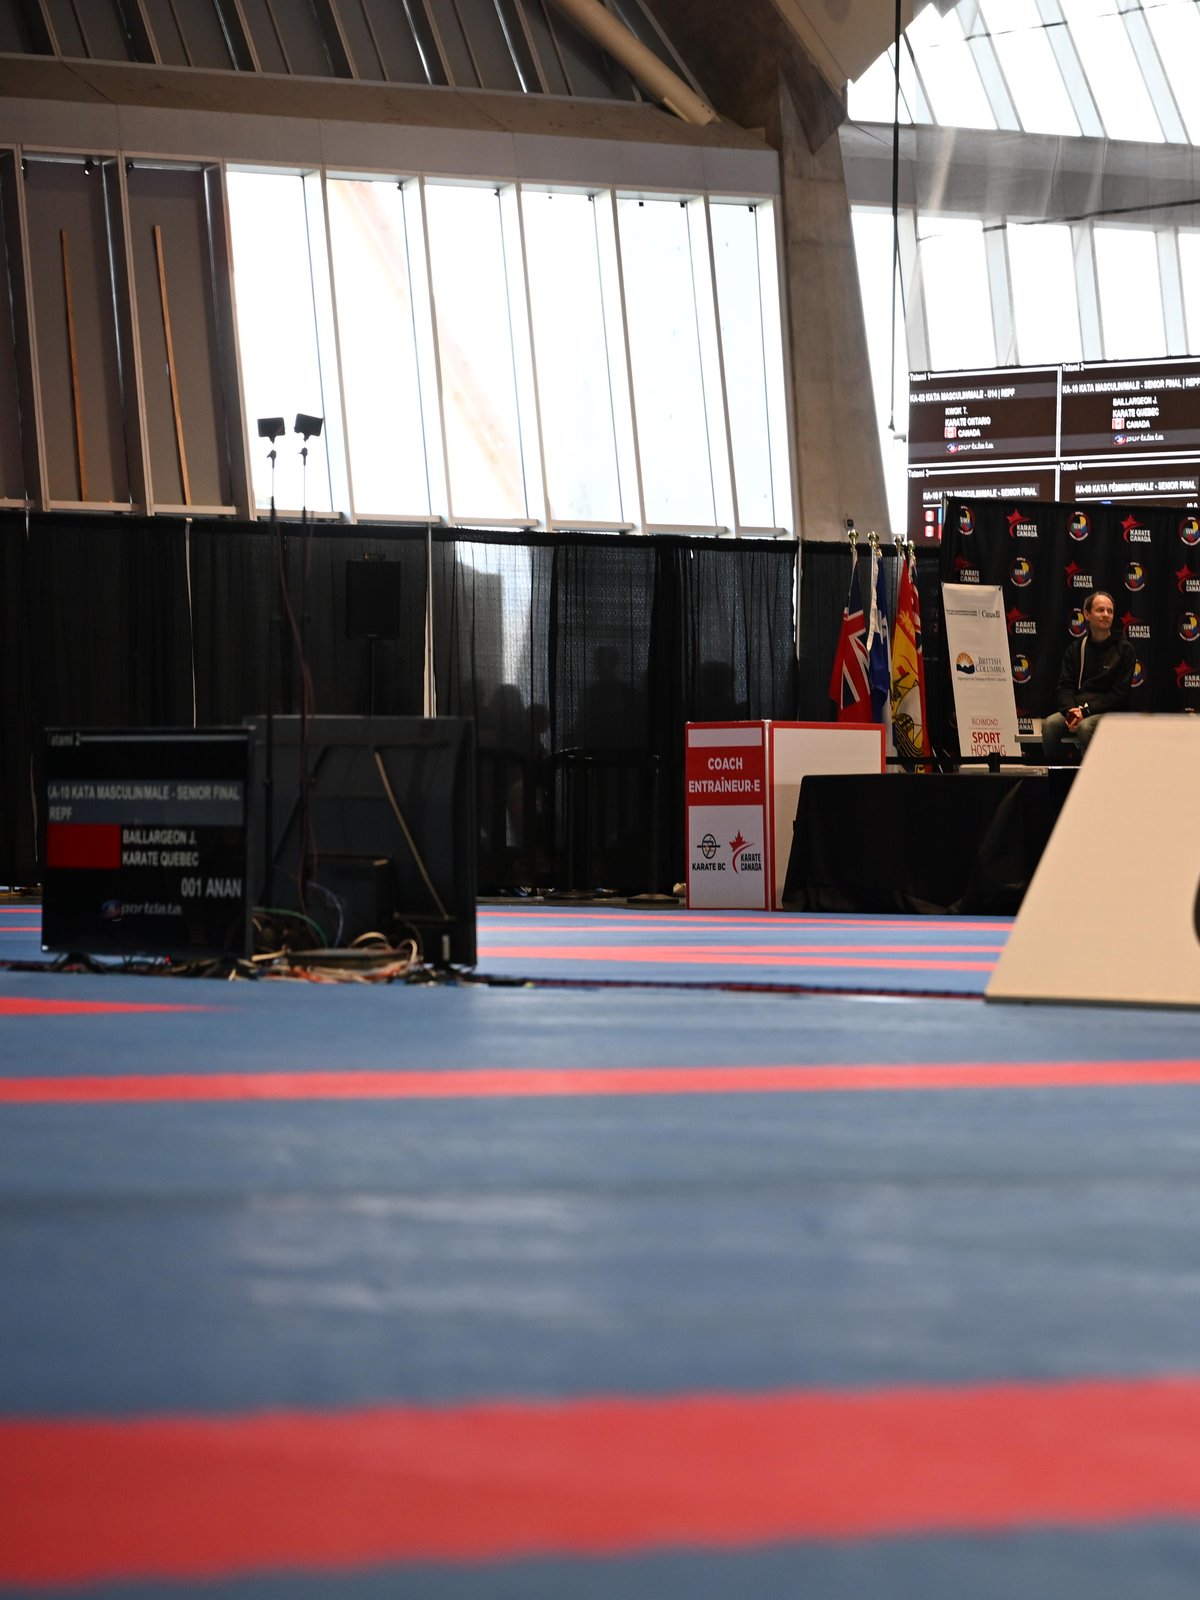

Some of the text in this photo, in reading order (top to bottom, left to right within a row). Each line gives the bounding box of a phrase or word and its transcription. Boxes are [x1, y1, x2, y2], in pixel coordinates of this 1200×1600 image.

[1079, 383, 1095, 392] KATA
[1144, 379, 1165, 389] SENIOR
[1165, 378, 1182, 388] FINAL
[926, 392, 940, 402] KATA
[1112, 396, 1152, 406] BAILLARGEON
[1112, 407, 1160, 418] KARATE QUEBEC
[945, 416, 991, 427] KARATE ONTARIO
[1126, 420, 1150, 429] CANADA
[958, 429, 981, 438] CANADA
[1000, 487, 1021, 497] SENIOR
[1021, 486, 1037, 496] FINAL
[1092, 483, 1108, 493] KATA
[1158, 480, 1179, 491] SENIOR
[1179, 480, 1196, 490] FINAL
[978, 656, 1001, 666] BRITISH
[976, 664, 1006, 673] COLUMBIA
[971, 718, 998, 726] RICHMOND
[48, 732, 81, 746] atami 2
[972, 732, 1000, 743] SPORT
[971, 745, 1006, 757] HOSTING
[708, 757, 743, 770] COACH
[72, 785, 95, 799] KATA
[176, 785, 212, 800] SENIOR
[213, 785, 240, 800] FINAL
[49, 806, 72, 820] REPF
[122, 830, 197, 845] BAILLARGEON J.
[122, 852, 199, 867] KARATE QUEBEC
[741, 853, 761, 862] KARATE
[691, 862, 726, 871] KARATE BC
[741, 863, 762, 871] CANADA
[181, 877, 242, 898] 001 ANAN
